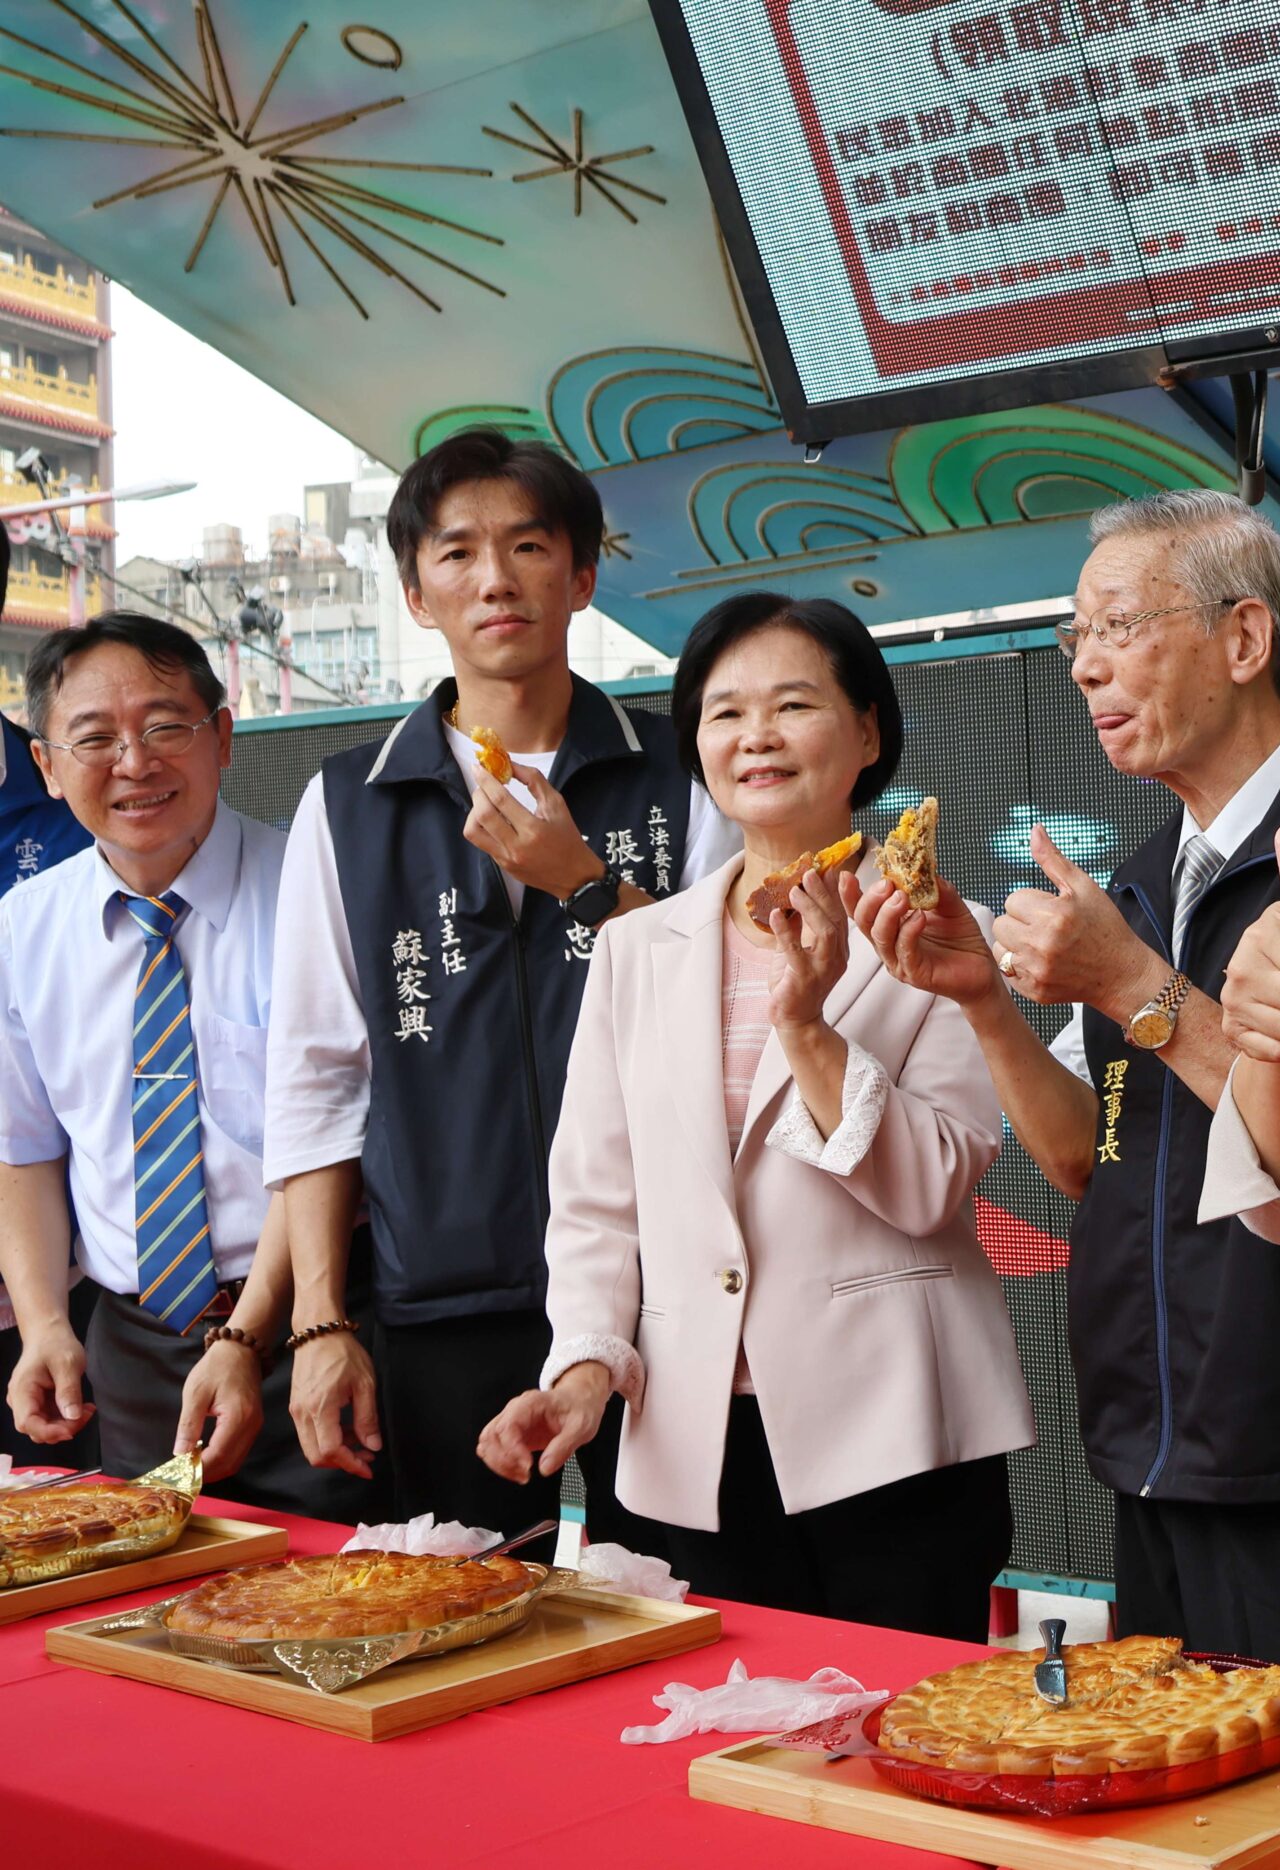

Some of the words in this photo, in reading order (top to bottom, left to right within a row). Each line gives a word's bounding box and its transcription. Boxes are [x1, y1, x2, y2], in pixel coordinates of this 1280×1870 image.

[647, 805, 673, 892] 立法委員
[438, 887, 467, 976] 副主任
[391, 929, 433, 1042] 蘇家興
[1096, 1059, 1129, 1164] 理事長
